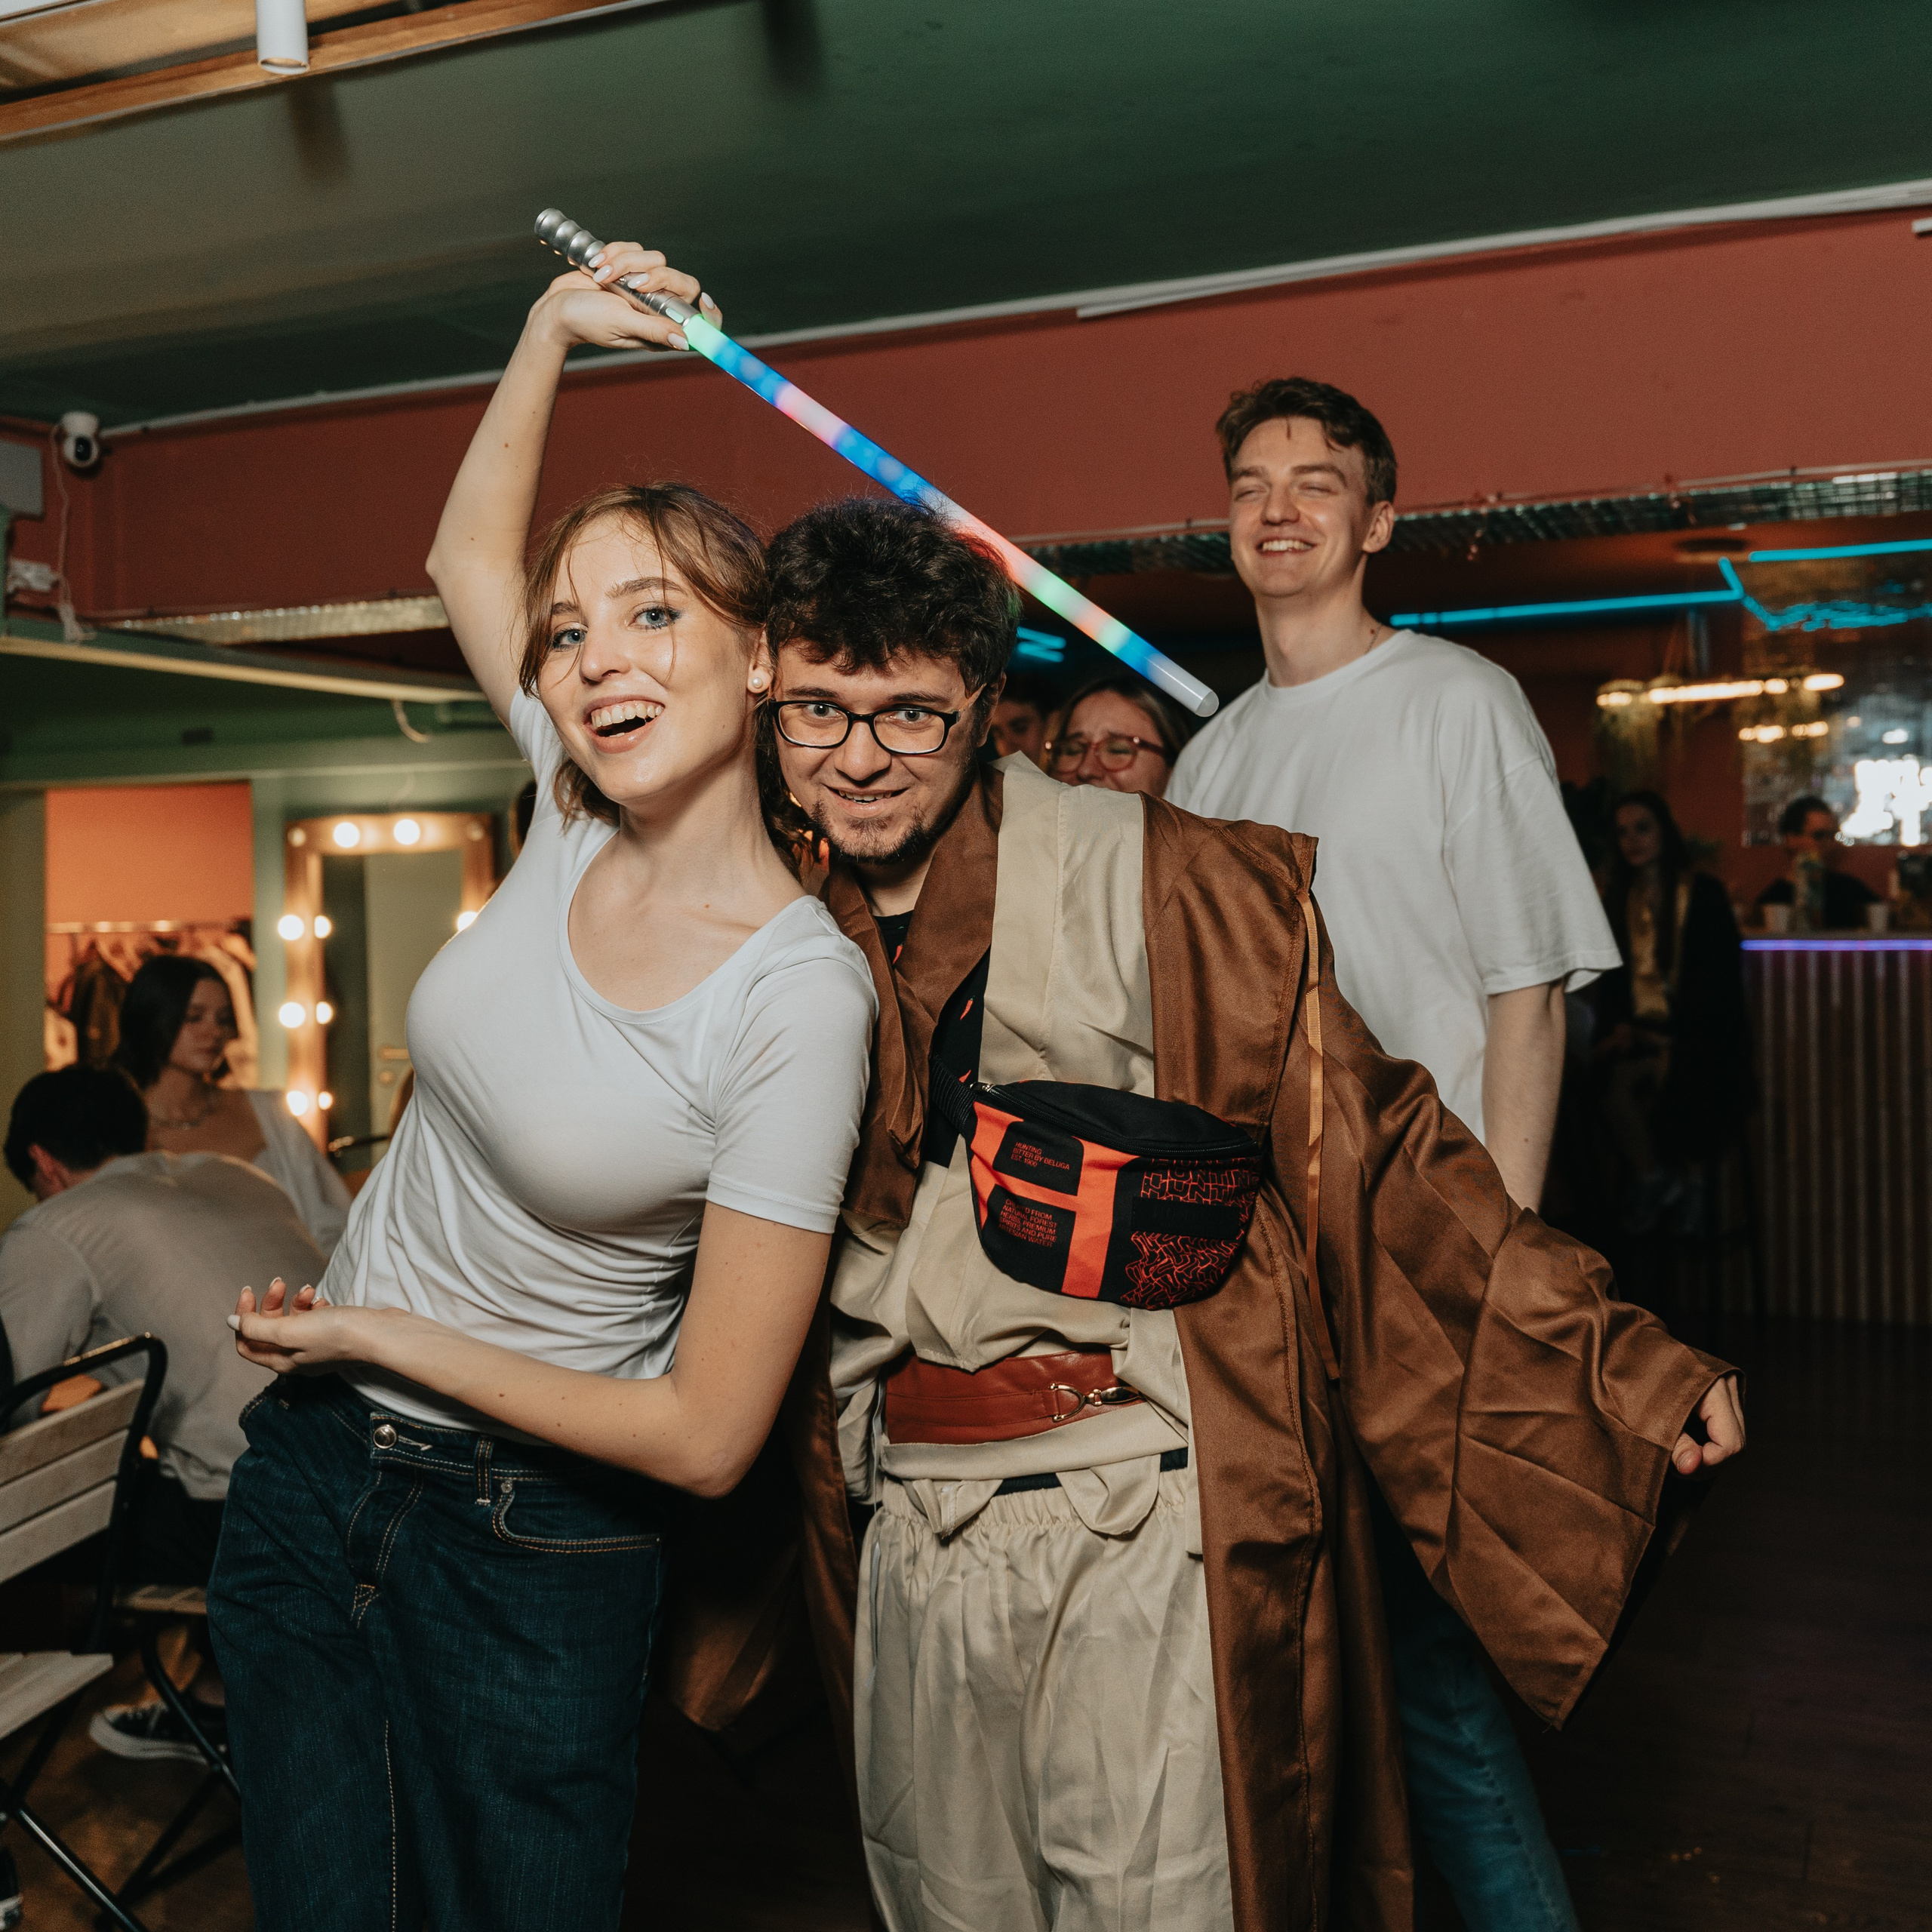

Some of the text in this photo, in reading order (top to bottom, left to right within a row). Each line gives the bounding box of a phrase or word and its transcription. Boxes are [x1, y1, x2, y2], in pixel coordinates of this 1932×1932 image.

[1015, 1142, 1041, 1155] HUNTING
[1013, 1148, 1033, 1159] BITTER
[1044, 1158, 1070, 1170] BELUGA
[1024, 1158, 1038, 1167] 1900
[1031, 1209, 1053, 1220] FROM
[1023, 1220, 1056, 1235] PREMIUM
[1029, 1216, 1057, 1228] FOREST
[1021, 1227, 1036, 1236] AND
[1037, 1232, 1057, 1242] PURE
[1028, 1235, 1052, 1247] WATER
